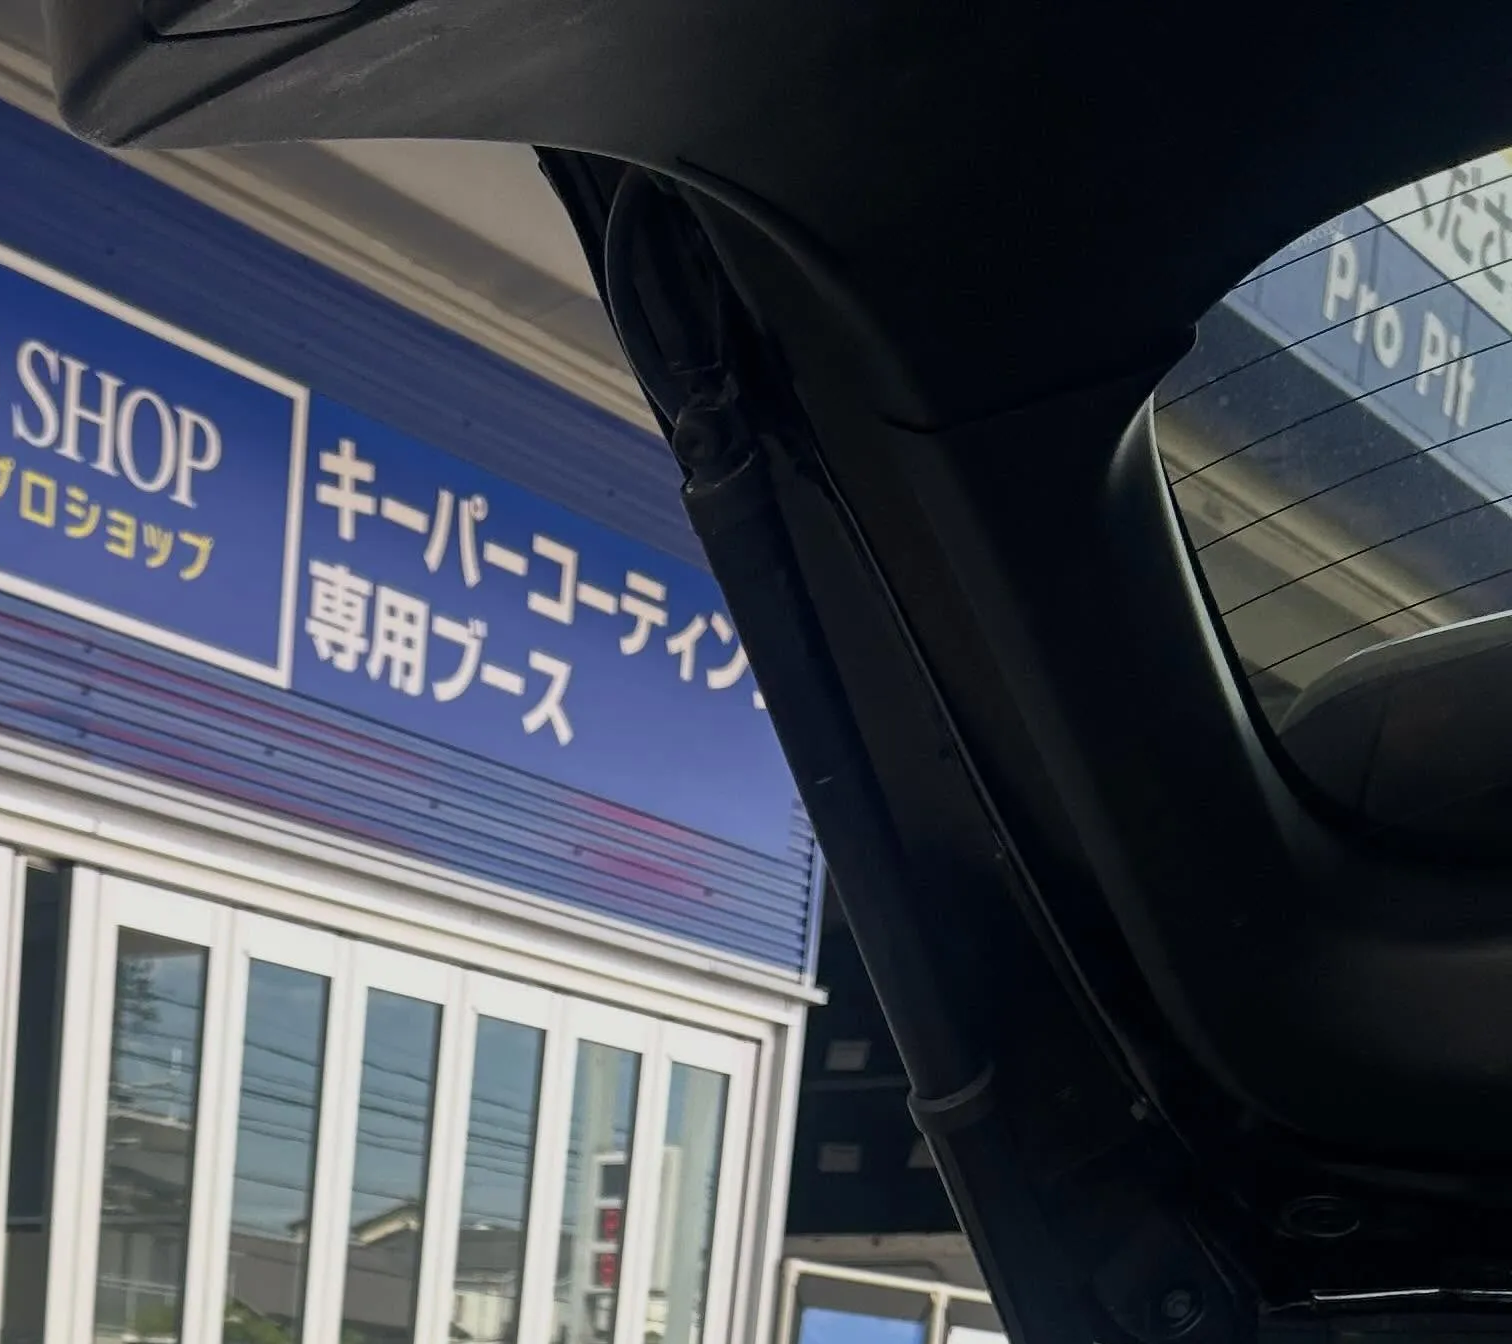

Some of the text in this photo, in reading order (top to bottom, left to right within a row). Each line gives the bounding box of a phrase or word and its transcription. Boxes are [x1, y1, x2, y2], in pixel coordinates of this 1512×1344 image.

[11, 340, 222, 508] SHOP
[1323, 232, 1476, 427] Pro Pit
[305, 558, 573, 747] 専用ブース
[315, 437, 768, 711] キーパーコーティン
